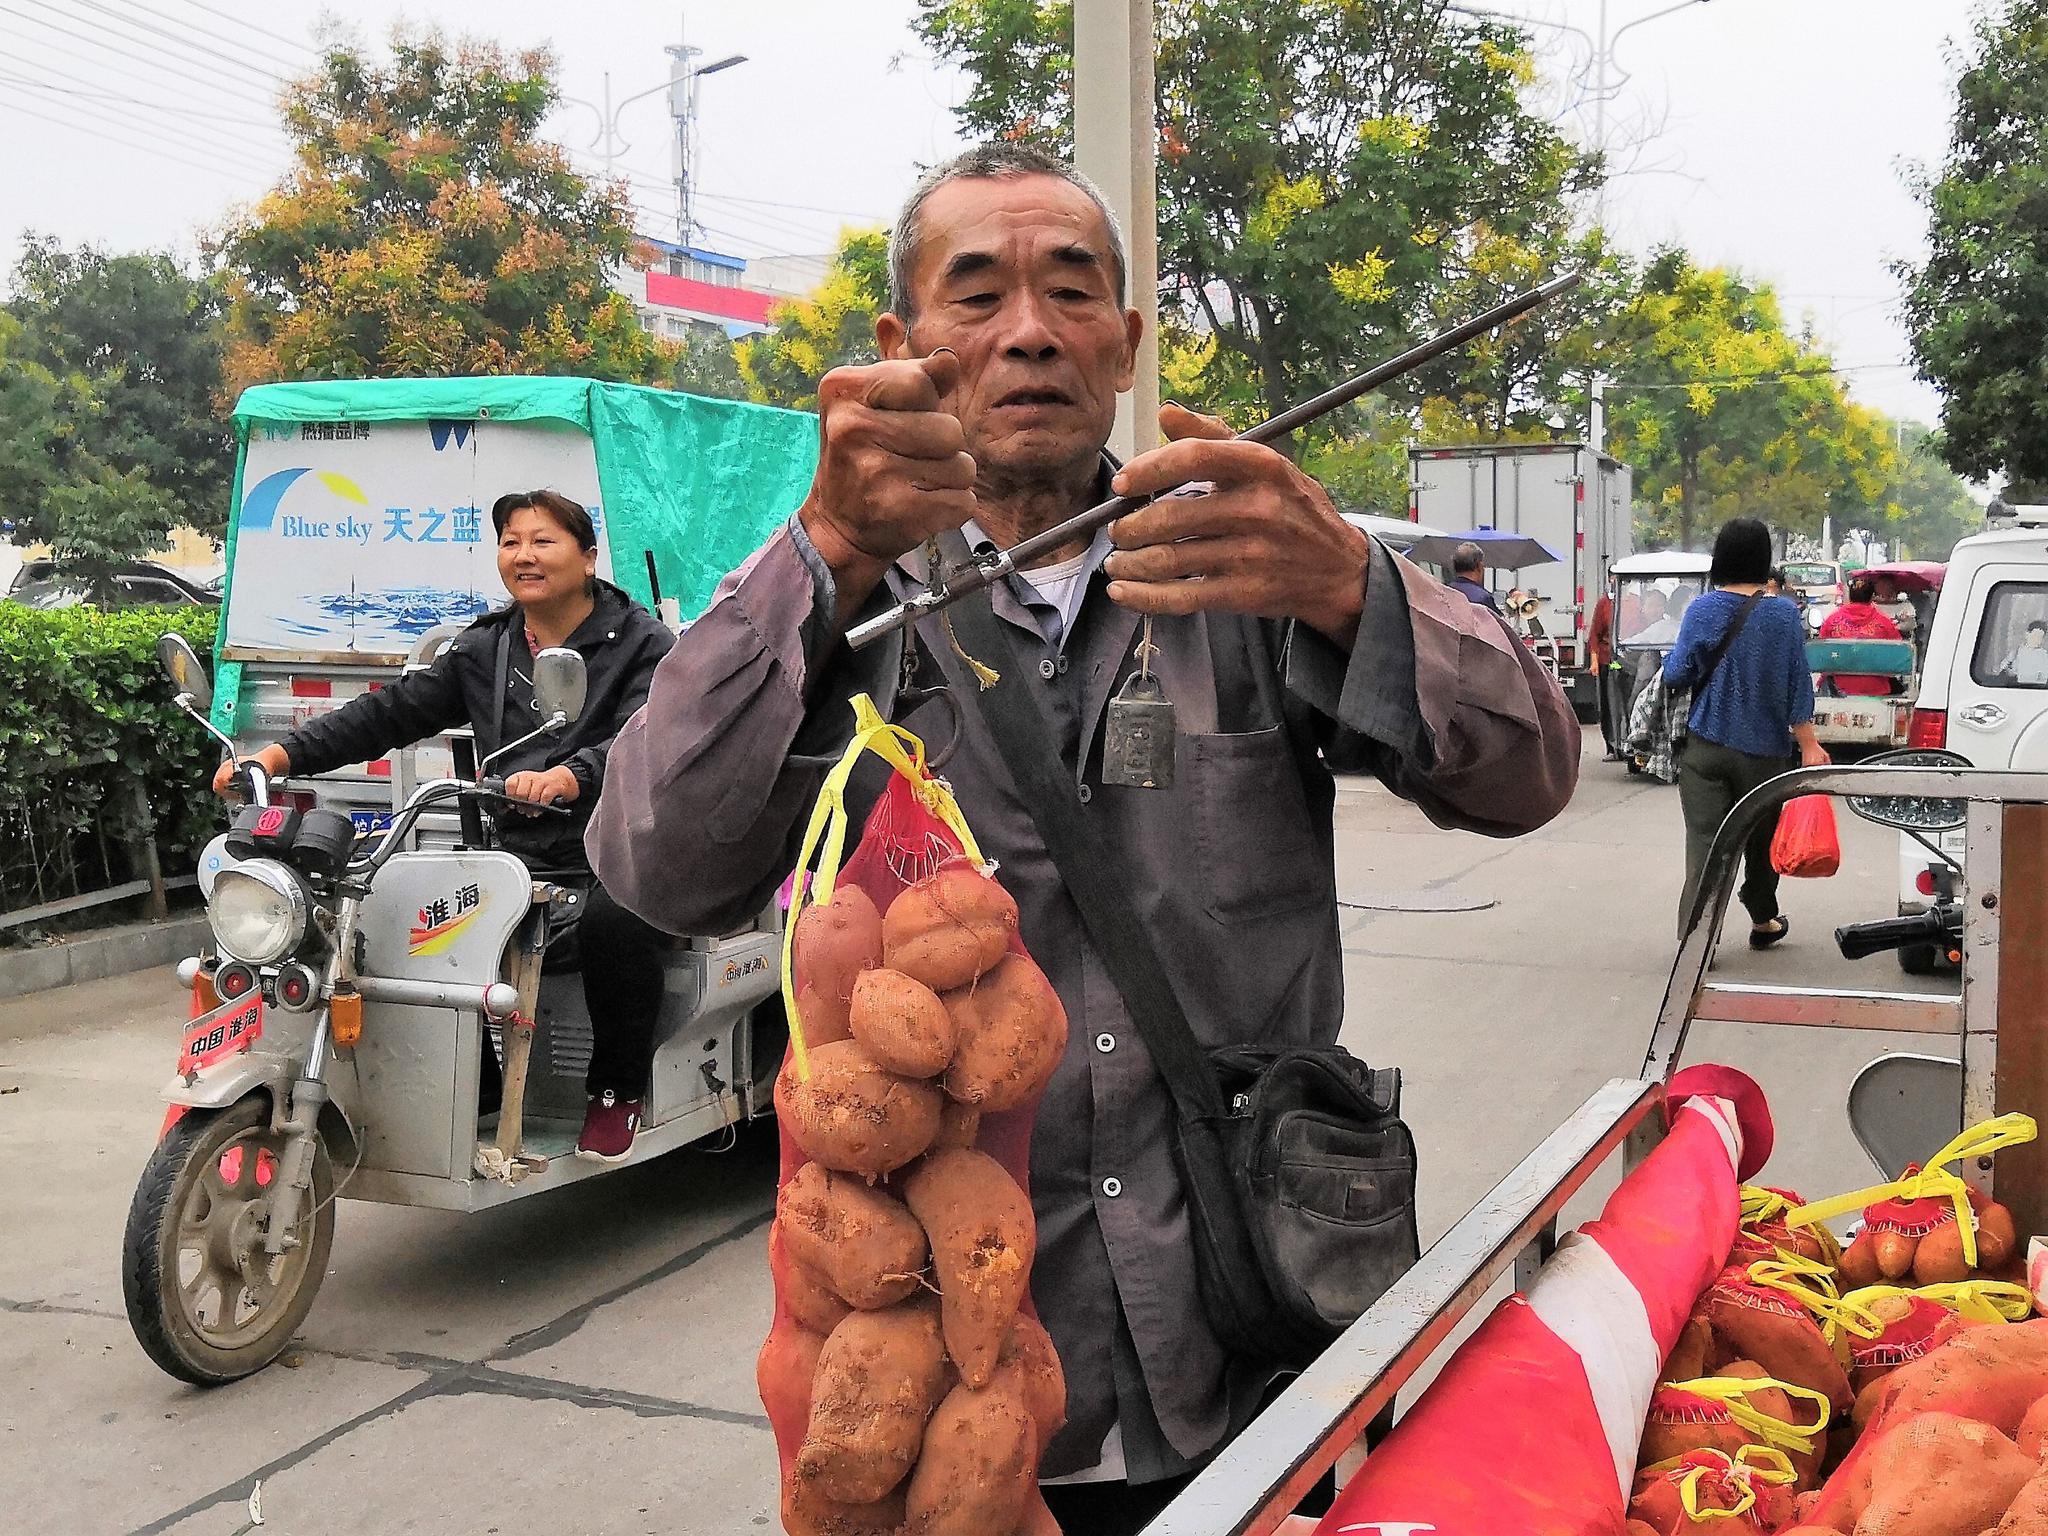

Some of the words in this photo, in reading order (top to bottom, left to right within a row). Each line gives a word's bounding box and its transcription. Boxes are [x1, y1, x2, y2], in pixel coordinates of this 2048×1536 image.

[281, 515, 330, 537] Blue
[335, 514, 373, 546] sky
[383, 507, 482, 542] 天之蓝
[425, 882, 480, 931] 淮海
